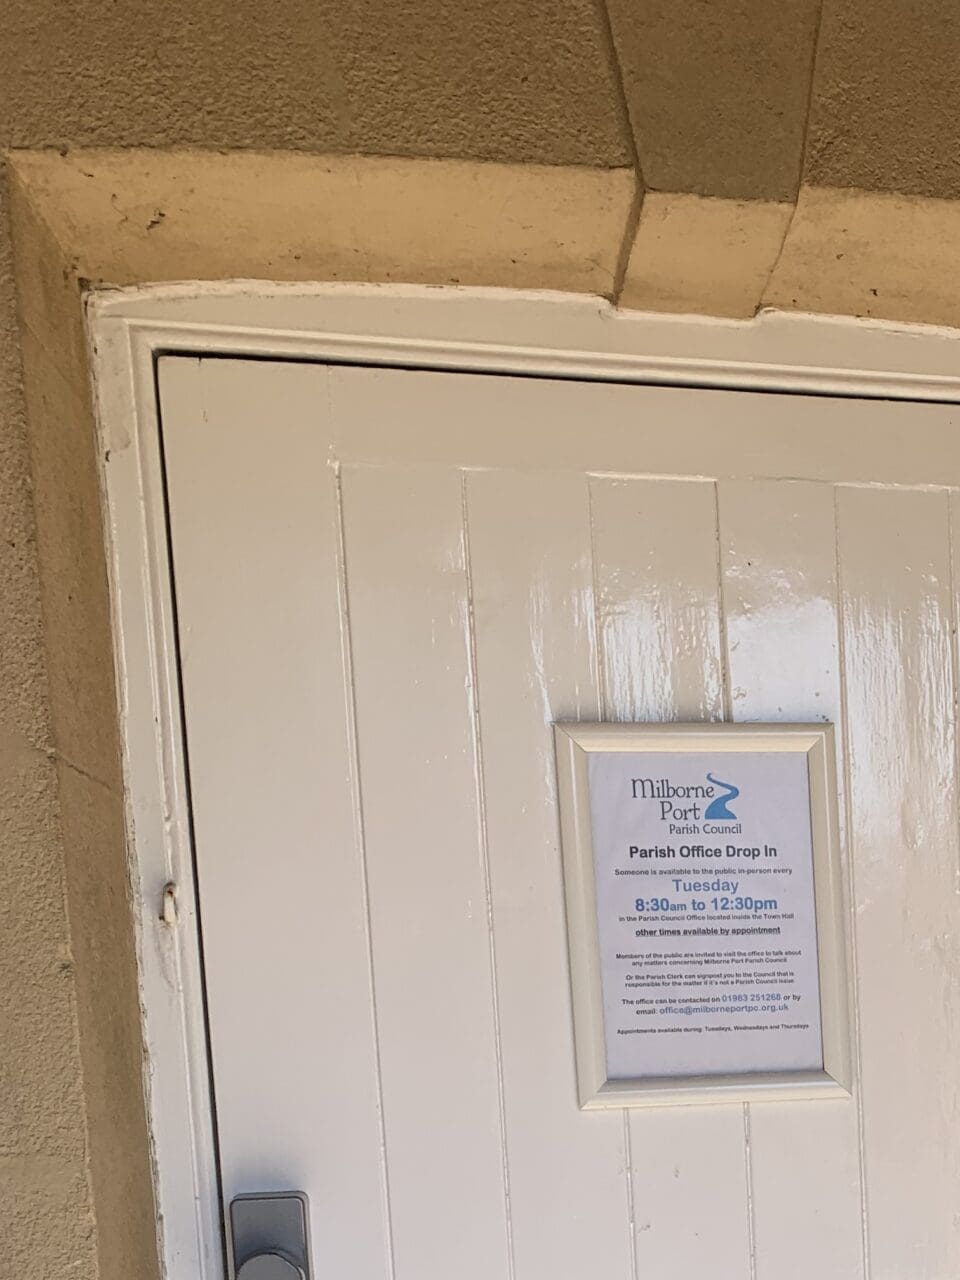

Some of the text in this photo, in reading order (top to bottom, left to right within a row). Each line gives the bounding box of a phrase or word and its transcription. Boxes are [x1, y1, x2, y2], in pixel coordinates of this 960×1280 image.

[631, 778, 714, 798] Milborne
[660, 800, 700, 820] Port
[669, 823, 741, 835] Parish Council
[629, 845, 777, 860] Parish Office Drop In
[672, 879, 739, 894] Tuesday
[635, 897, 777, 913] 8:30am to 12:30pm
[635, 926, 781, 937] other times available by appointment
[792, 994, 801, 1002] by
[659, 1003, 789, 1015] office@milborneportpc.org.uk
